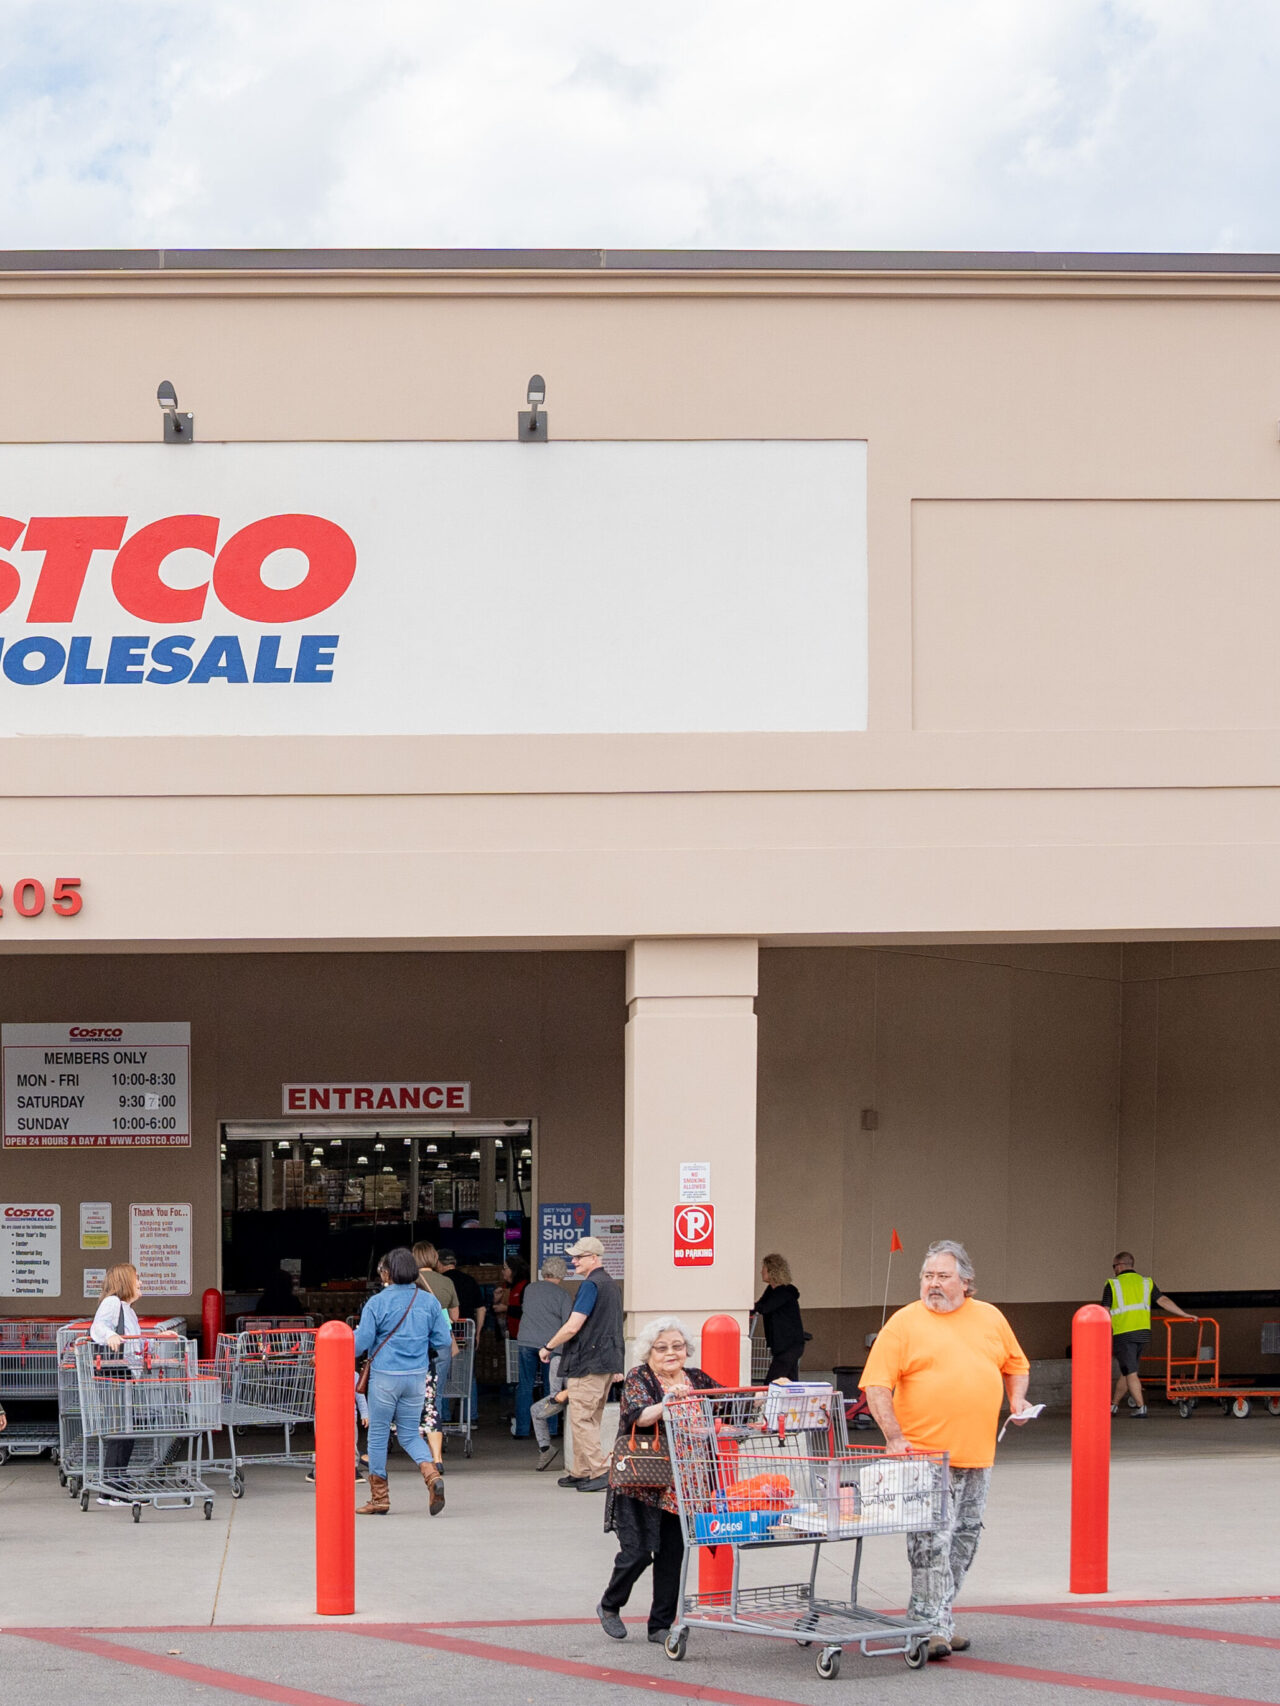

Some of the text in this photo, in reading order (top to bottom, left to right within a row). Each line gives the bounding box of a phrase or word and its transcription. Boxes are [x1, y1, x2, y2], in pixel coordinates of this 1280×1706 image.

[69, 1026, 123, 1038] COSTCO
[44, 1052, 148, 1064] MEMBERS ONLY
[17, 1074, 47, 1086] MON
[59, 1074, 80, 1086] FRI
[112, 1073, 176, 1086] 10:00-8:30
[17, 1096, 85, 1108] SATURDAY
[288, 1087, 465, 1110] ENTRANCE
[18, 1118, 70, 1130] SUNDAY
[112, 1117, 176, 1130] 10:00-6:00
[6, 1136, 188, 1146] OPEN 24 HOURS A DAY AT WWW.COSTCO.COM
[4, 1207, 54, 1217] COSTCO
[134, 1208, 188, 1216] Thank You For...
[543, 1215, 572, 1226] FLU
[543, 1228, 584, 1240] SHOT
[675, 1249, 712, 1258] NO PARKING
[720, 1521, 742, 1534] pepsi
